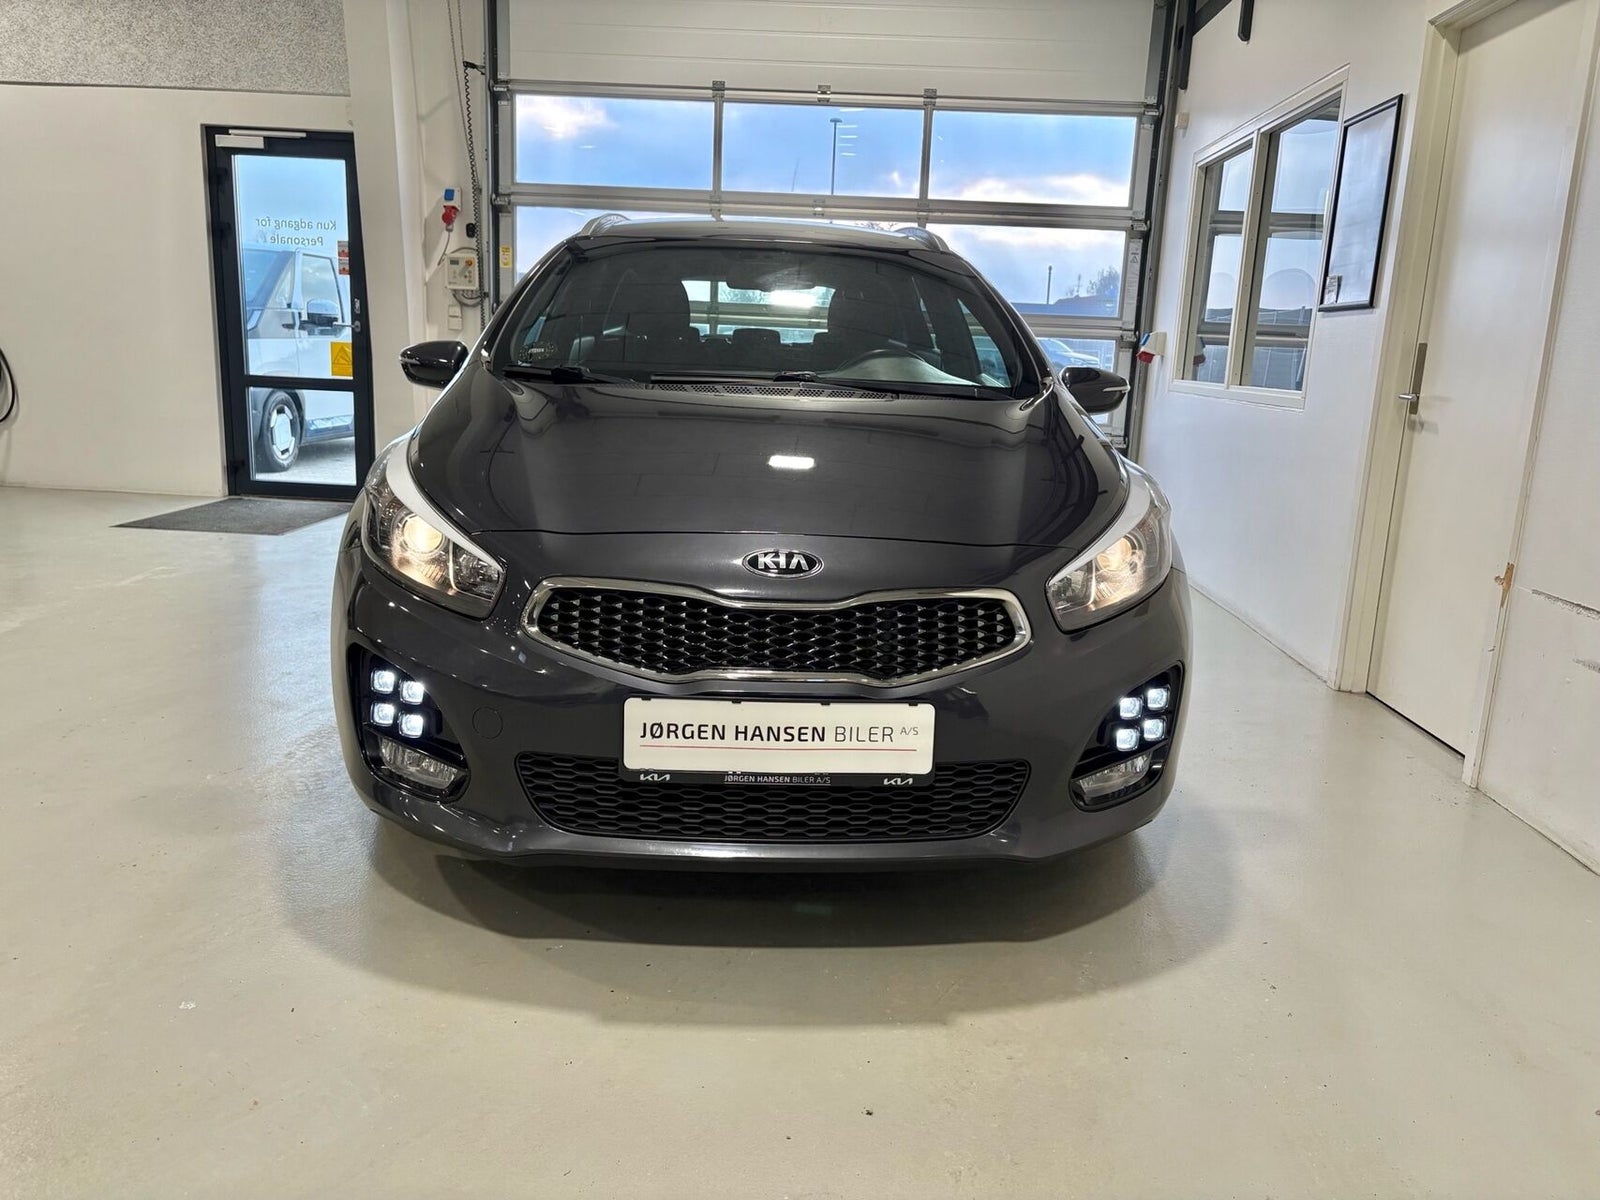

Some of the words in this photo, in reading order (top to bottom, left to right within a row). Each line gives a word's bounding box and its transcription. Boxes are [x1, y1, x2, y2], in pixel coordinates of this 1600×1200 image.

[757, 552, 809, 571] KIA
[640, 721, 726, 741] JØRGEN
[734, 724, 826, 742] HANSEN
[834, 725, 894, 743] BILER
[900, 726, 919, 736] A/S
[724, 774, 756, 783] JØRGEN
[757, 775, 791, 783] HANSEN
[792, 776, 815, 784] BILER
[816, 776, 831, 784] A/S
